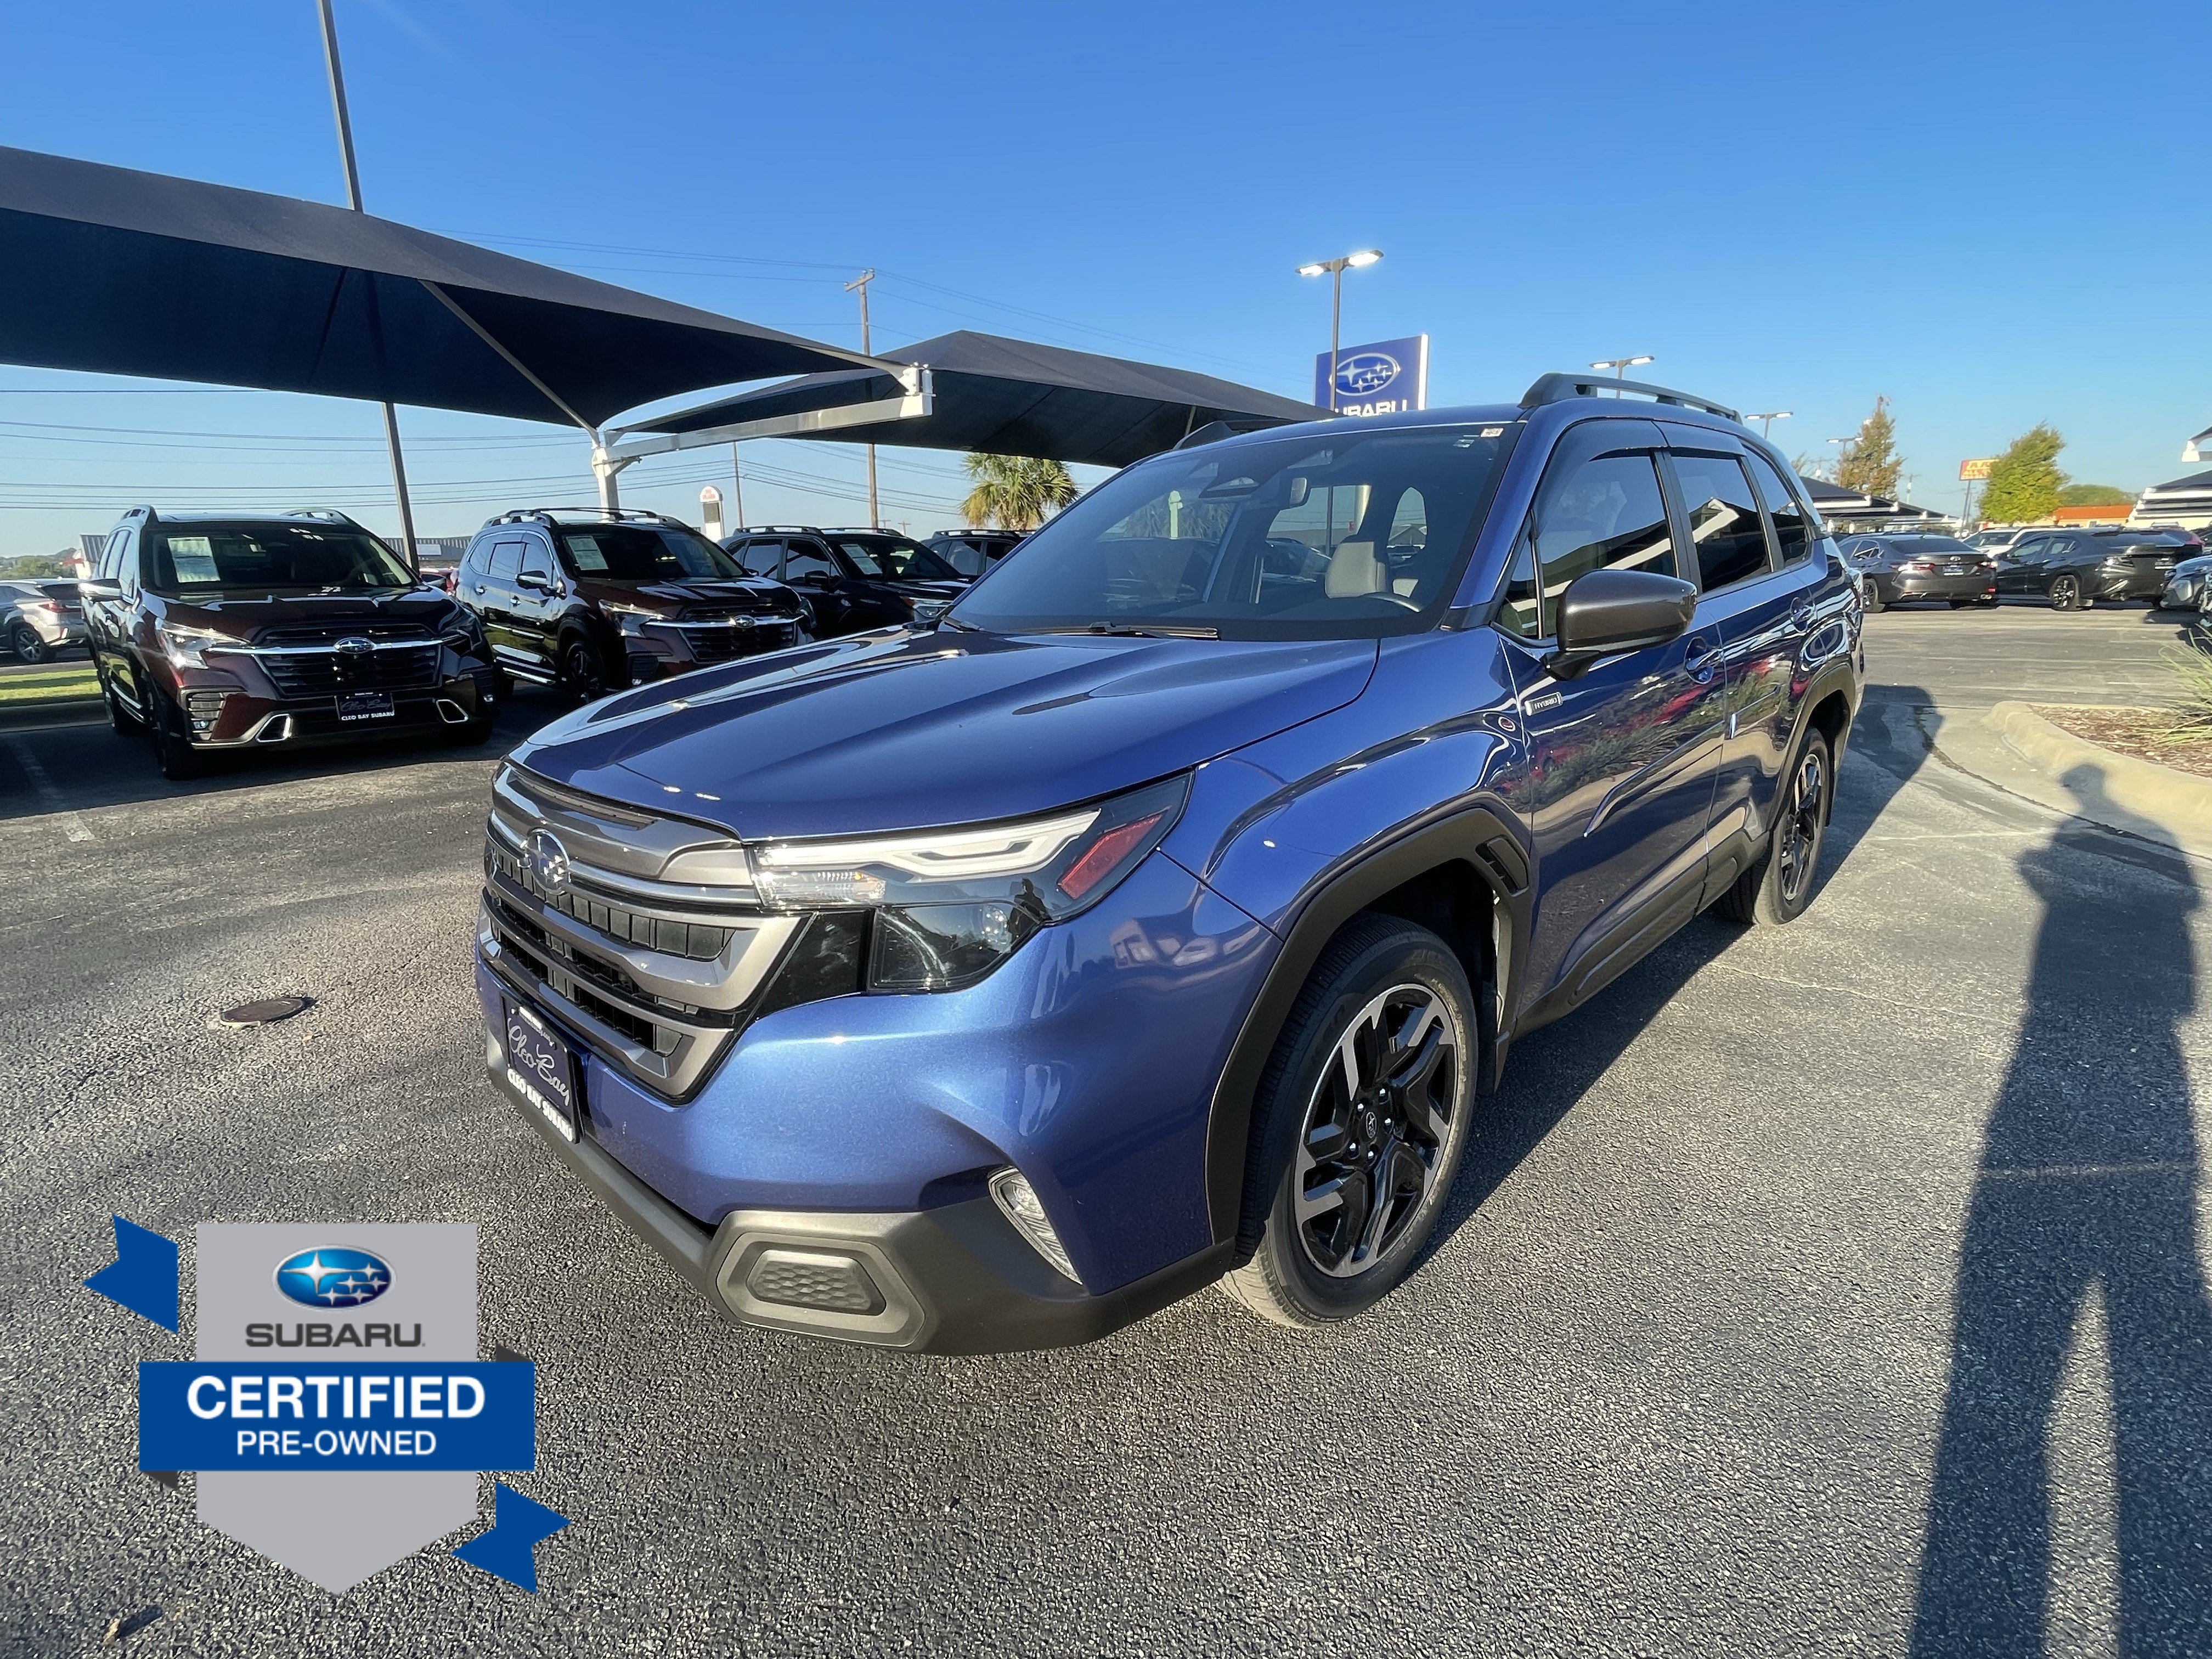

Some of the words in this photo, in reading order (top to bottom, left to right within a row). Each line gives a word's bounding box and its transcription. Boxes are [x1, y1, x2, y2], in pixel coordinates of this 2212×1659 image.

[507, 1068, 527, 1094] CLEO
[527, 1084, 542, 1109] BAY
[541, 1100, 573, 1142] SUBARU
